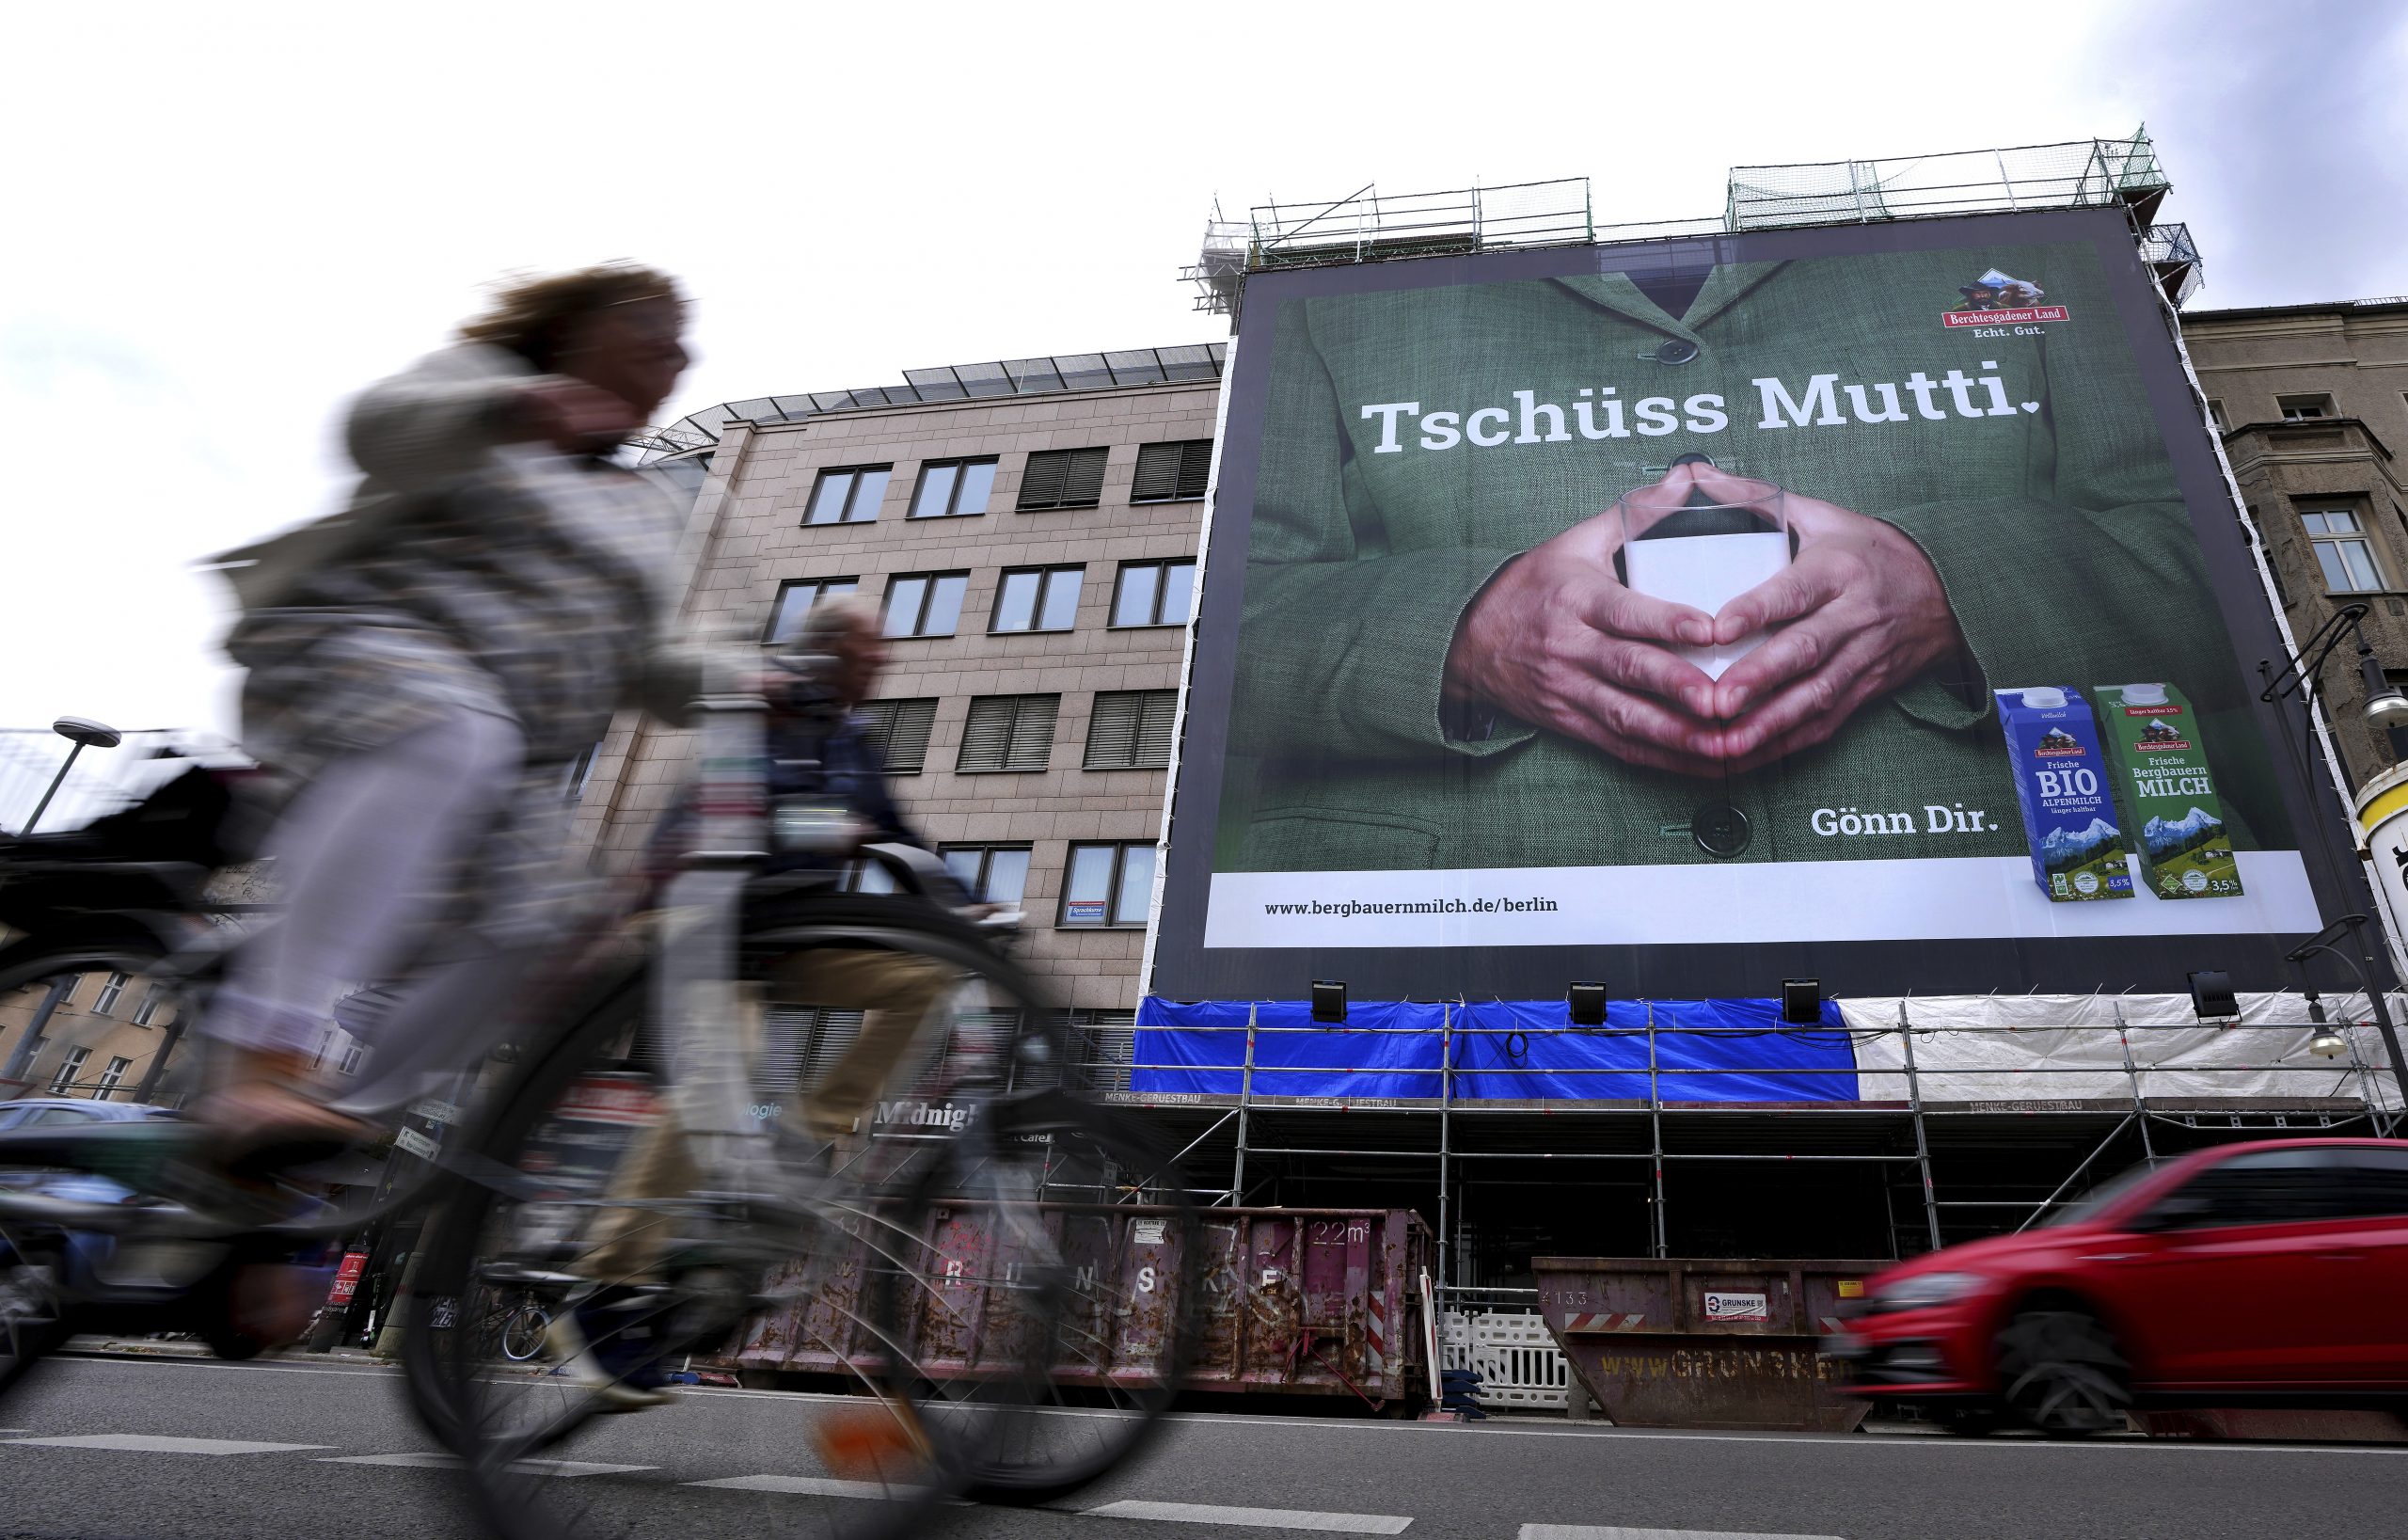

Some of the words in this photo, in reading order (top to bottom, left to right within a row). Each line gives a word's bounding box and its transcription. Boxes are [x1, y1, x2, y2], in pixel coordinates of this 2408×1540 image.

[1950, 311, 2033, 325] Berchtesgadener
[2035, 309, 2061, 320] Land
[1973, 327, 2010, 339] Echt.
[2014, 325, 2045, 336] Gut.
[1361, 388, 1729, 453] Tschüss
[2047, 760, 2080, 770] Frische
[2148, 756, 2185, 766] Frische
[2132, 766, 2208, 779] Bergbauern
[2036, 769, 2098, 798] BIO
[2136, 777, 2212, 798] MILCH
[2042, 796, 2102, 807] ALPENMILCH
[1811, 807, 1916, 836] Gönn
[1264, 897, 1559, 918] www.bergbauernmilch.de/berlin
[1104, 1092, 1201, 1103] MENKE-GERUESTBAU
[1970, 1100, 2083, 1112] MENKE-GERUESTBAU
